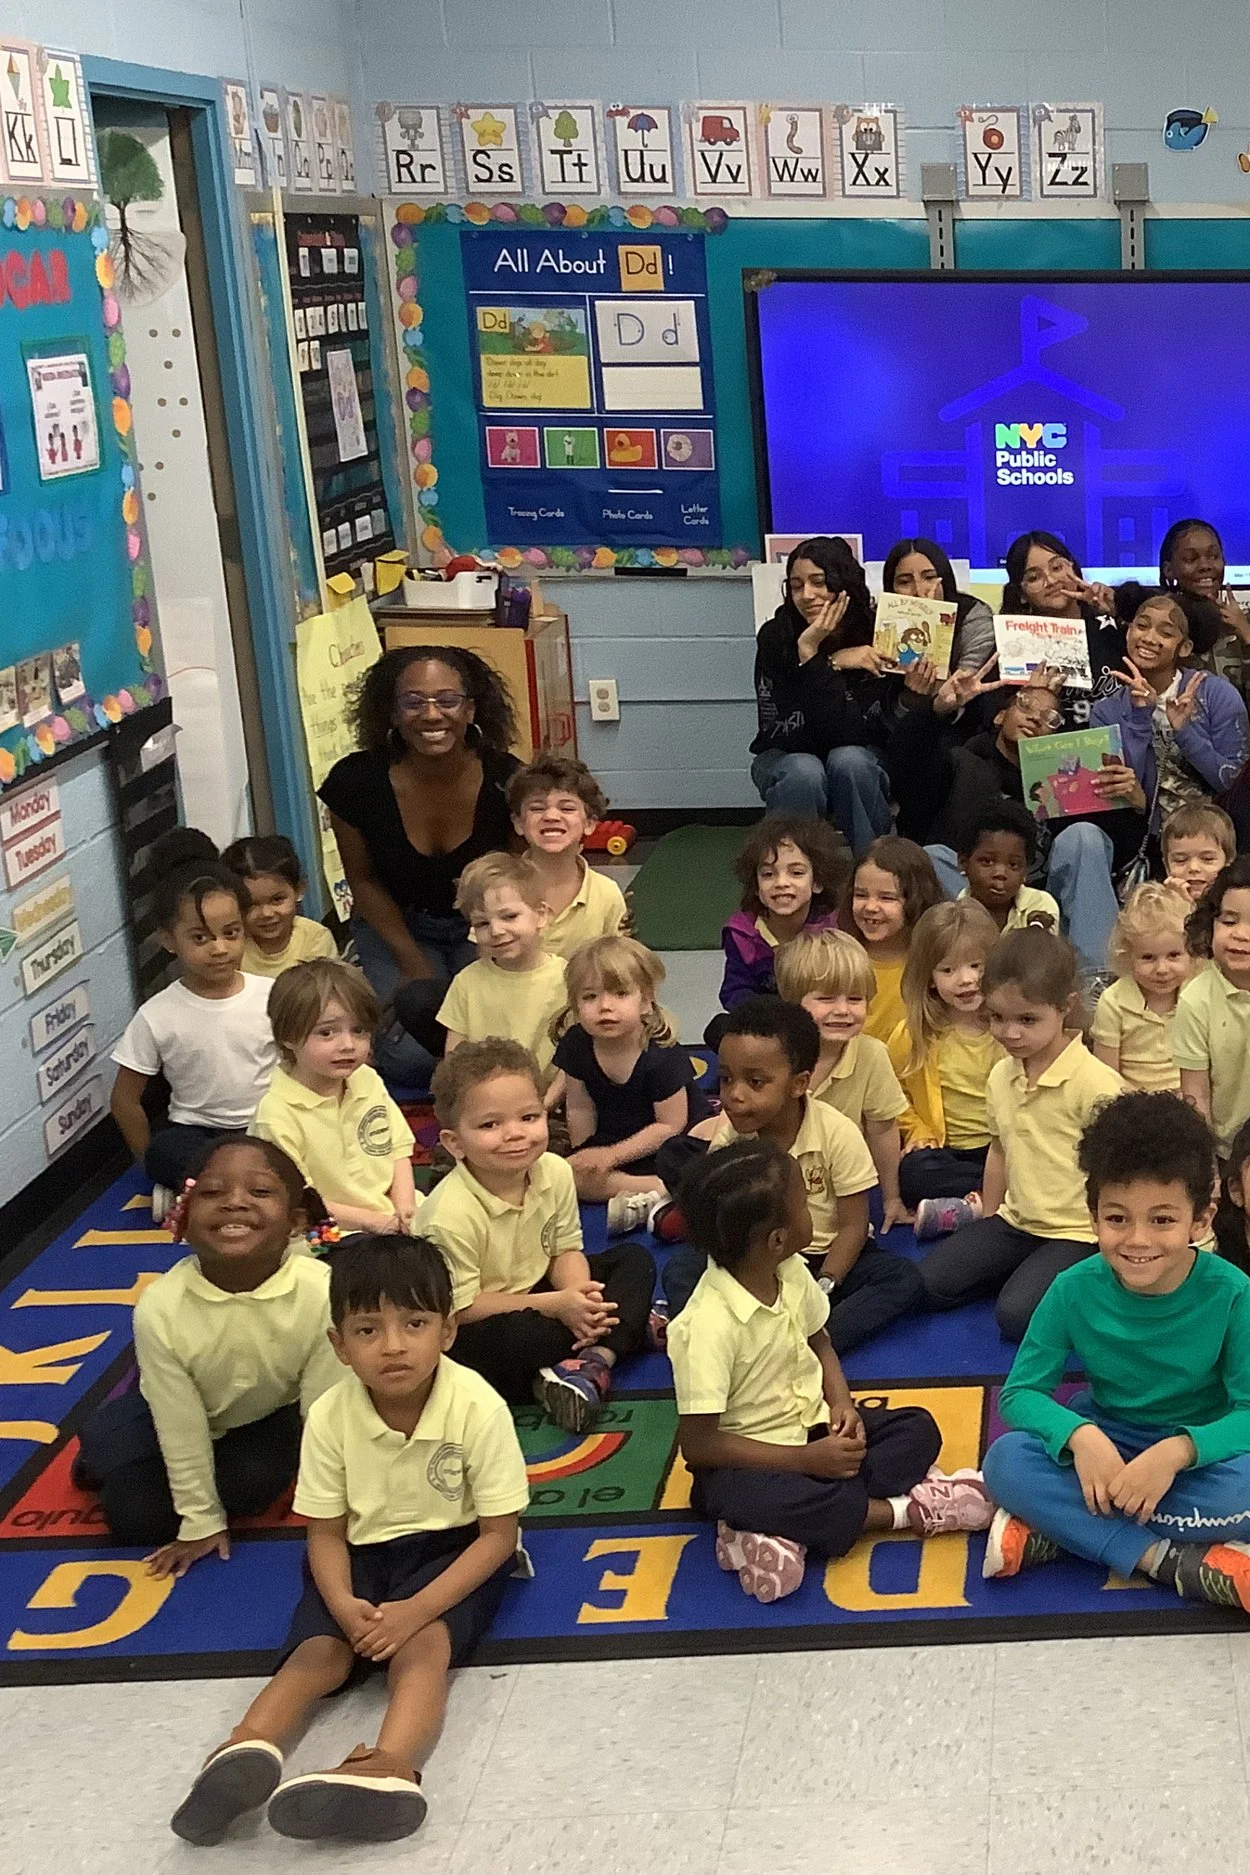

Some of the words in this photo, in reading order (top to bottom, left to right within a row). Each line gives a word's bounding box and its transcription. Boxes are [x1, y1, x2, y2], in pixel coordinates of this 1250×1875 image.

[7, 112, 37, 163] Kk
[396, 151, 437, 183] Rr
[473, 150, 514, 183] Ss
[551, 150, 588, 183] Tt
[624, 150, 667, 183] Uu
[701, 151, 742, 183] Vv
[772, 157, 819, 183] Ww
[851, 152, 891, 186] Xx
[973, 152, 1012, 193] Yy
[1048, 153, 1089, 186] Zz
[494, 248, 528, 273] All
[536, 248, 606, 274] About
[625, 252, 658, 275] Dd
[483, 312, 507, 329] Dd
[995, 423, 1067, 449] NYC
[996, 451, 1056, 467] Public
[997, 468, 1074, 485] Schools
[508, 507, 537, 520] Tracing
[538, 508, 565, 518] Cards
[602, 510, 626, 520] Photo
[627, 510, 653, 520] Cards
[681, 504, 708, 514] Letter
[683, 516, 709, 526] Cards
[1005, 619, 1048, 637] Freight
[1050, 622, 1077, 635] Train
[9, 790, 50, 827] Monday
[15, 833, 56, 871] Tuesday
[30, 934, 75, 978] Thursday
[45, 999, 76, 1035] Friday
[46, 1036, 89, 1086] Saturday
[594, 1486, 626, 1504] el
[576, 1534, 699, 1625] E
[7, 1560, 176, 1651] G
